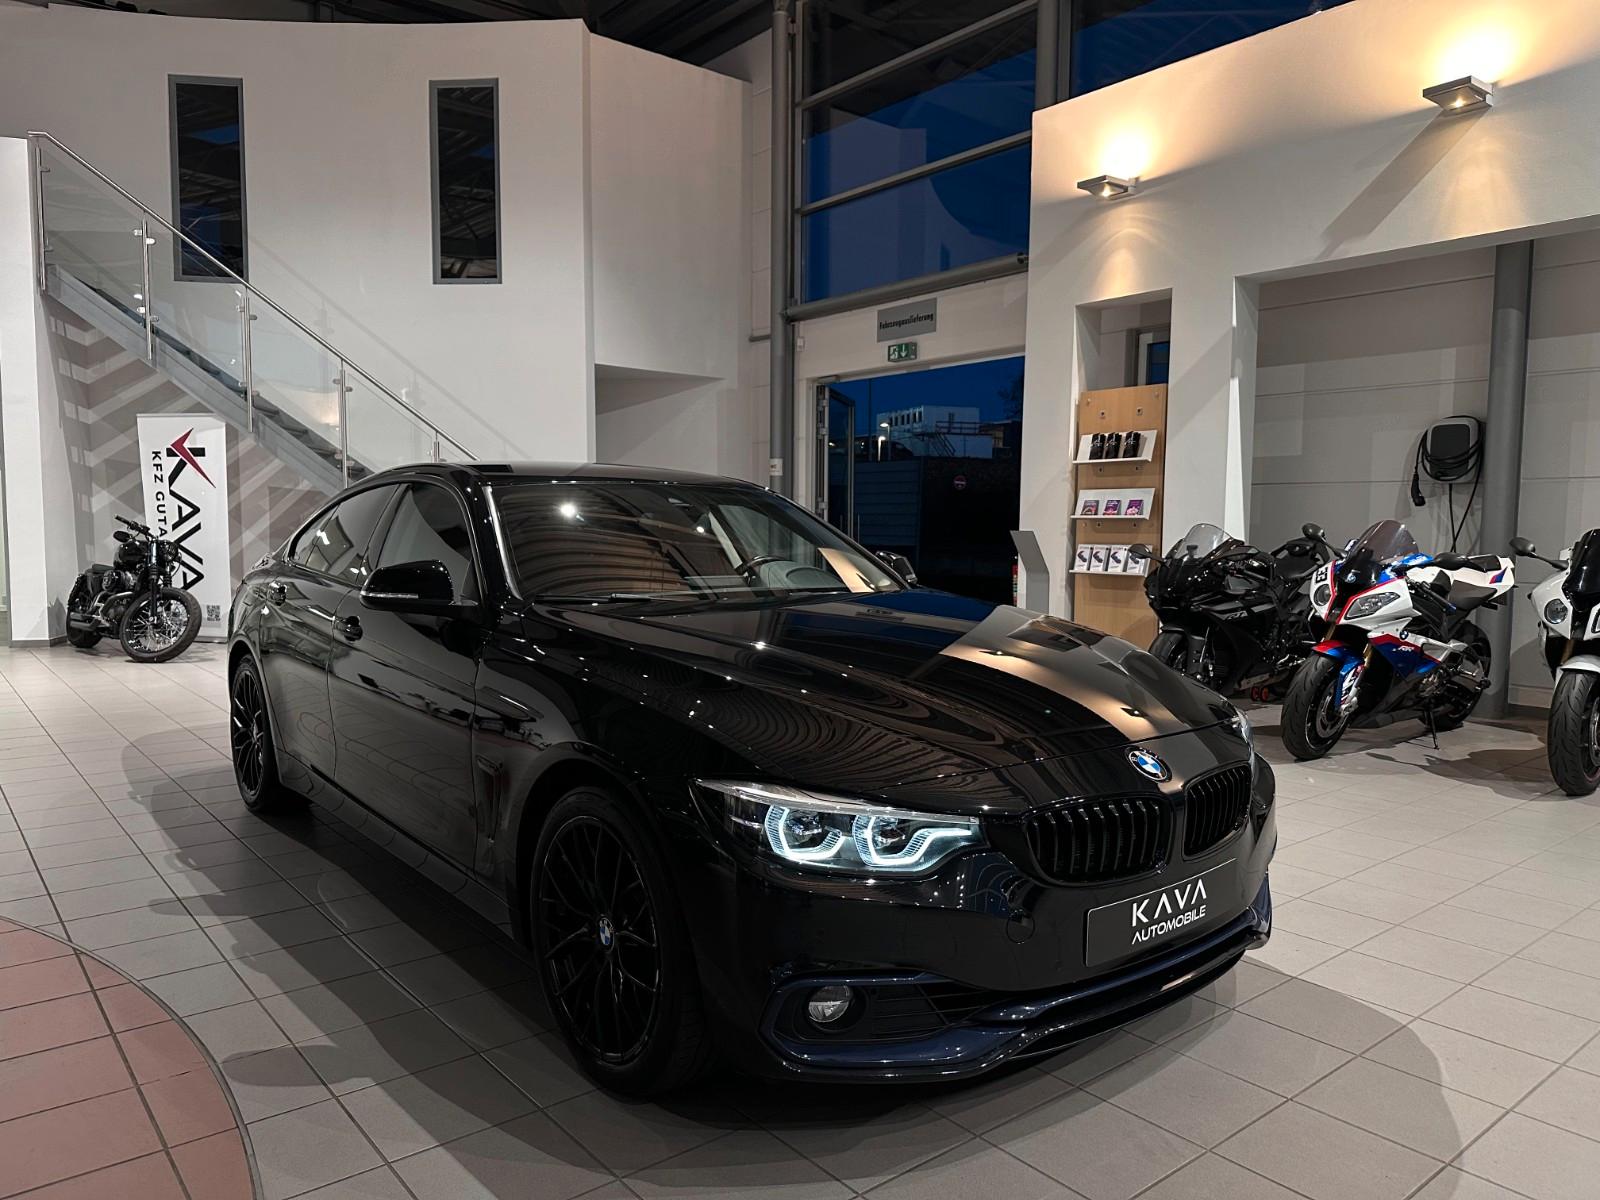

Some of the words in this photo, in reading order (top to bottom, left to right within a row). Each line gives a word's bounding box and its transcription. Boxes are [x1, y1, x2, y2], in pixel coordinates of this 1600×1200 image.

[151, 450, 164, 484] KFZ
[166, 428, 216, 590] KAVA
[1131, 878, 1207, 928] KAVA
[1131, 904, 1207, 945] AUTOMOBILE
